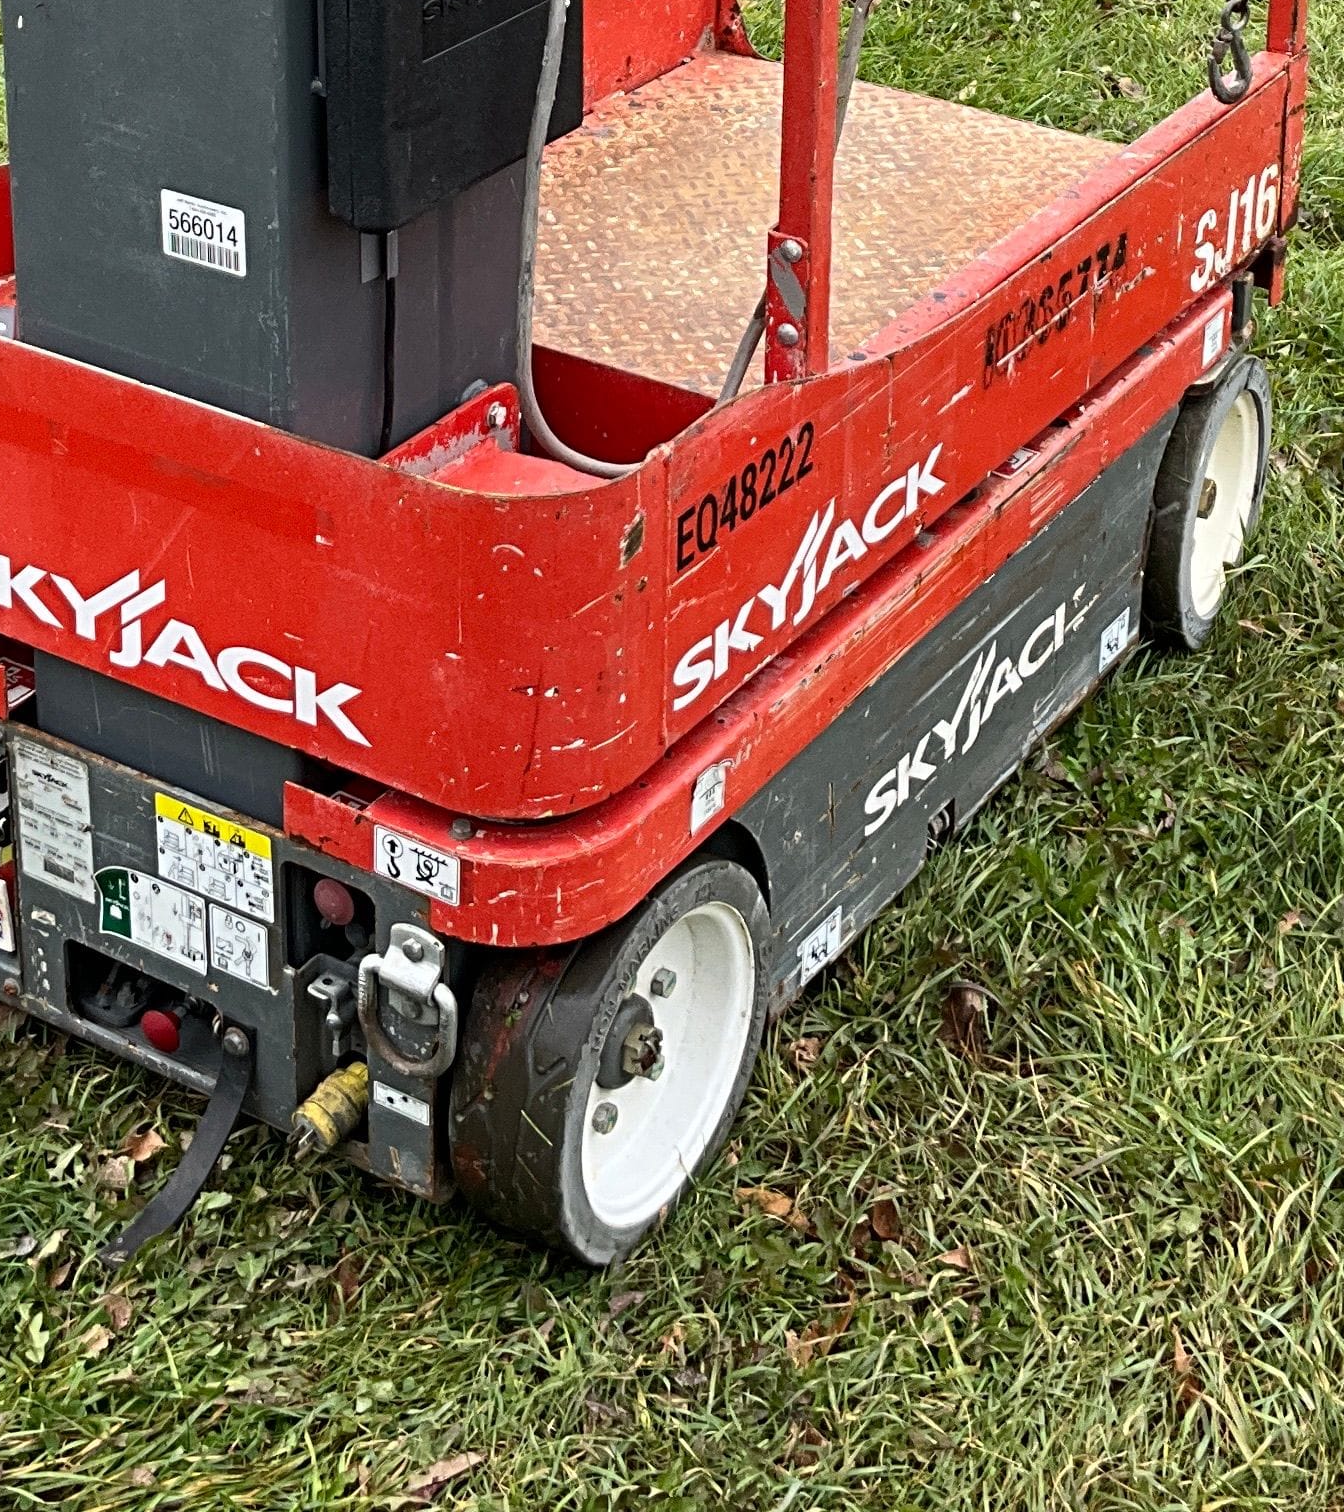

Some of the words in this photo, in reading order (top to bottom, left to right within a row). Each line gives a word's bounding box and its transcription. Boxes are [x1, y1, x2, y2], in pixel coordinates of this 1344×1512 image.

[169, 208, 238, 247] 566014
[1190, 163, 1278, 292] SJ16
[676, 421, 815, 573] EQ48222
[672, 442, 947, 712] SKYJACK
